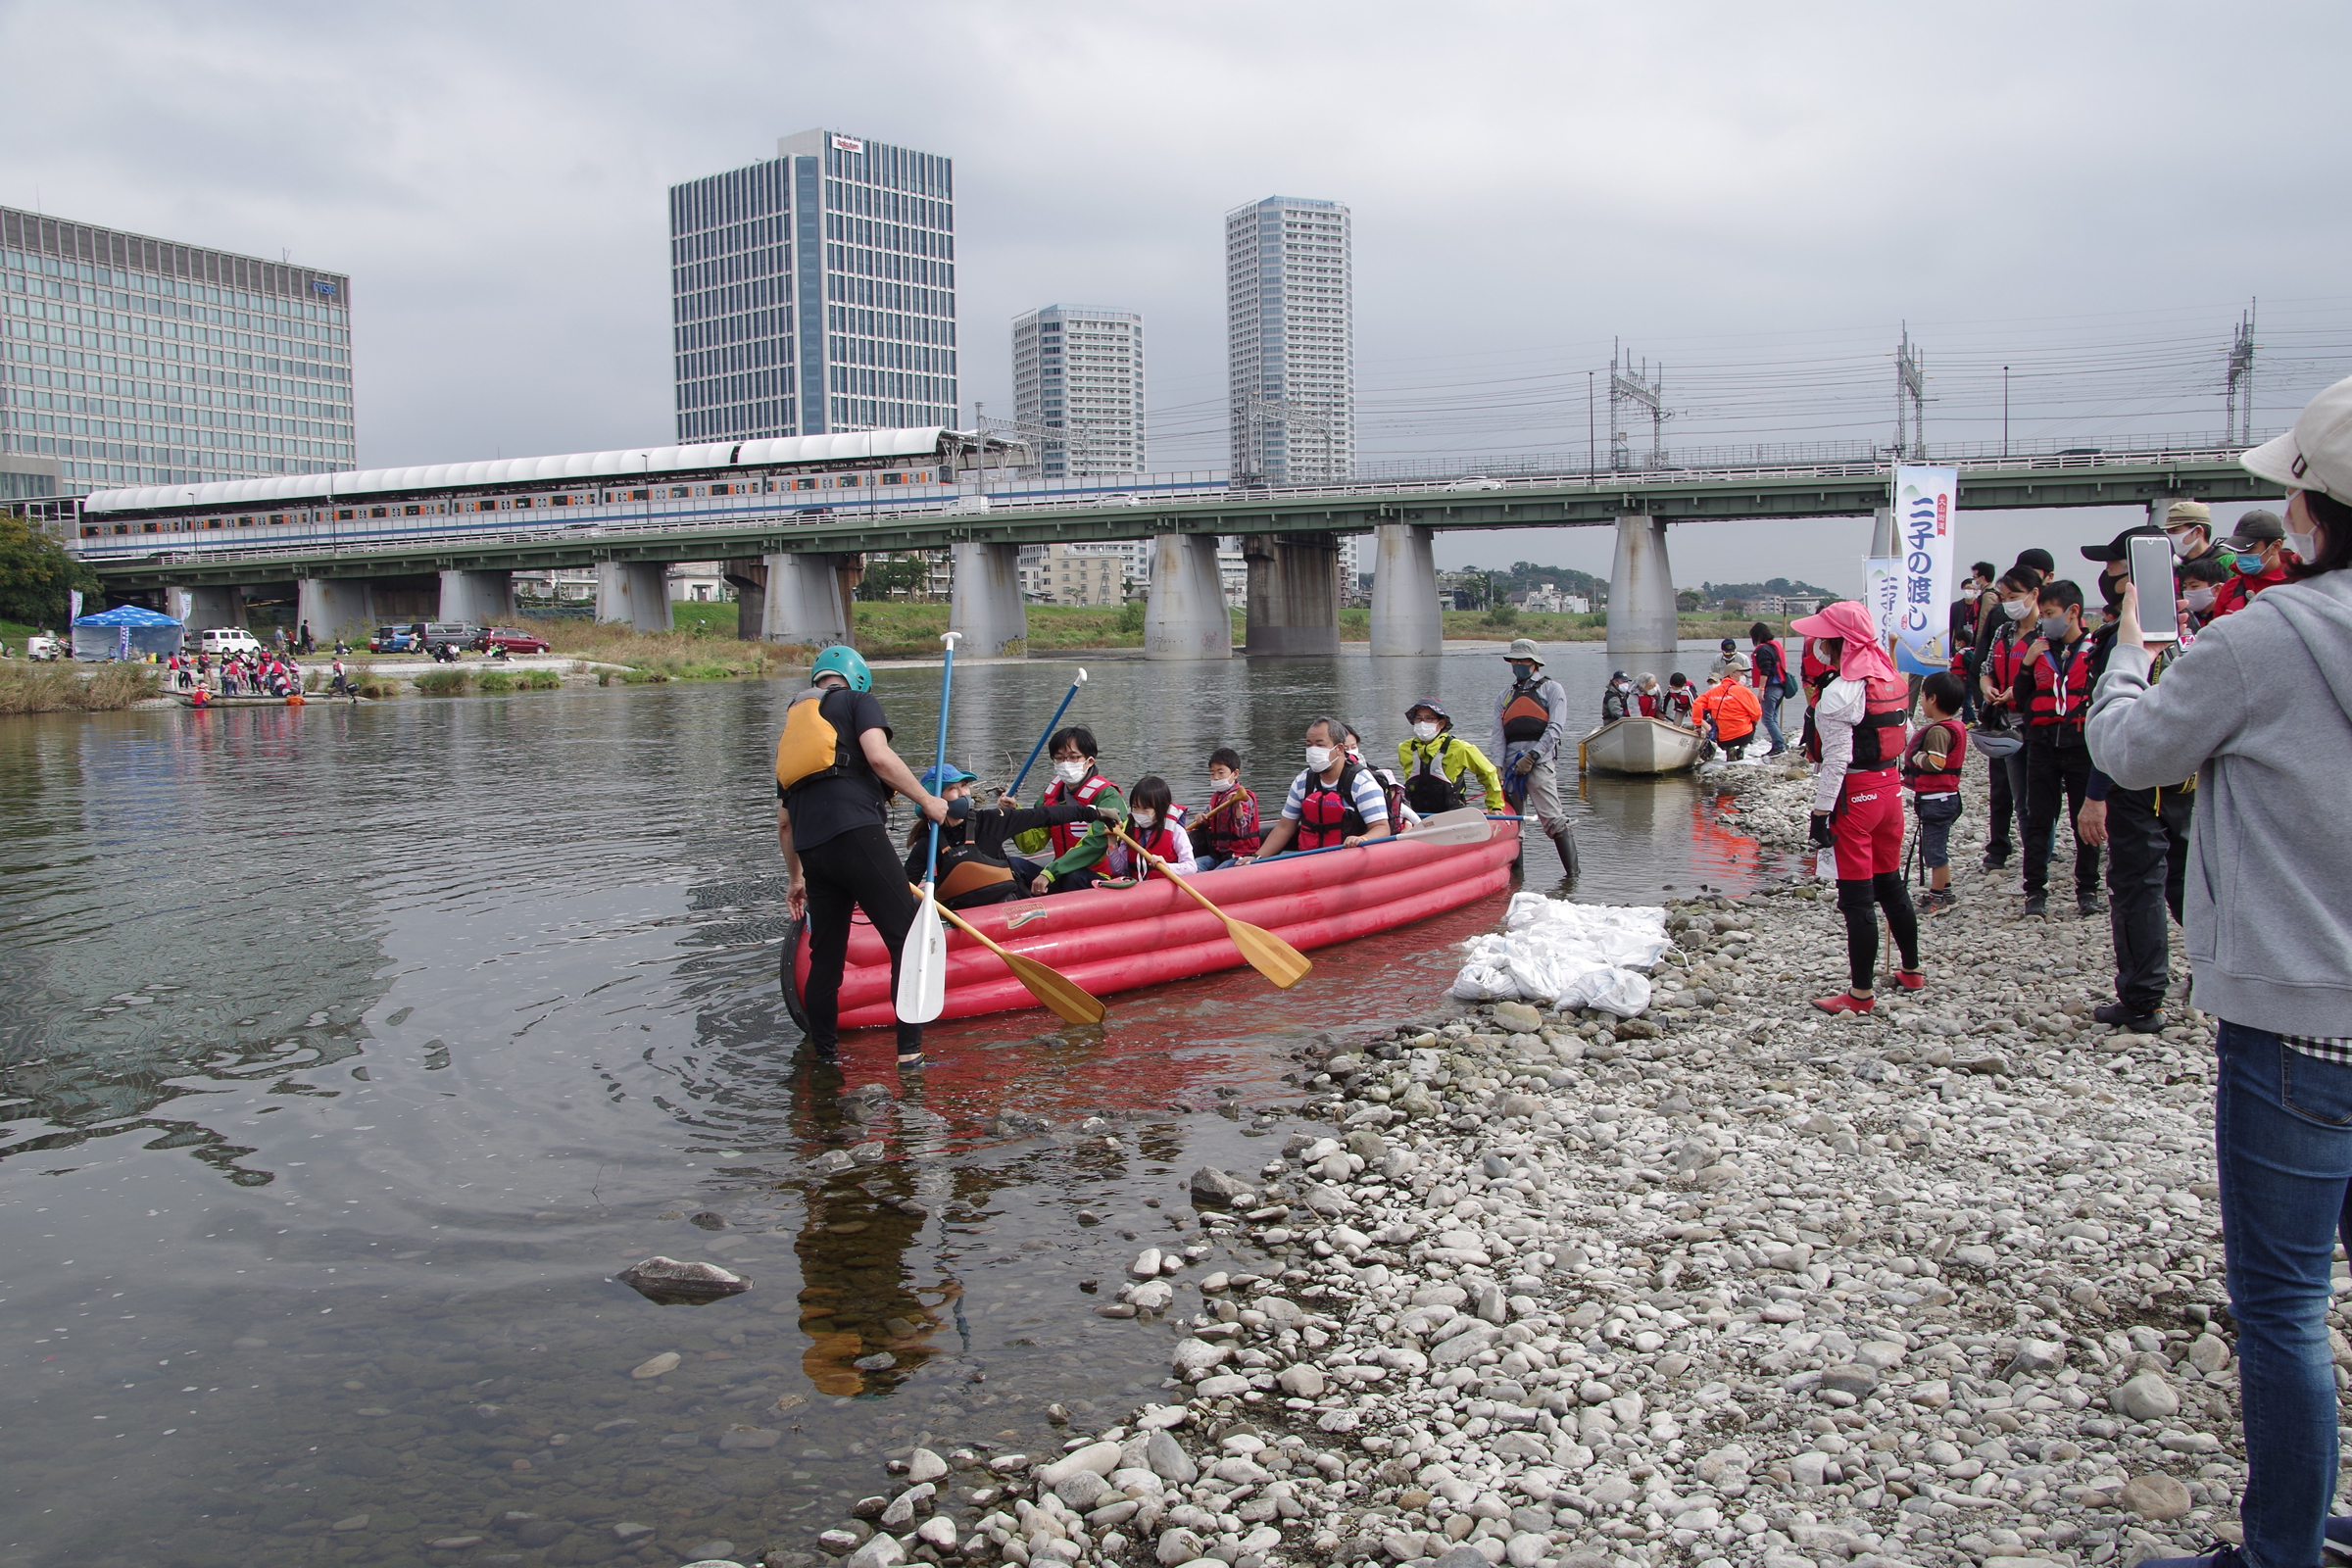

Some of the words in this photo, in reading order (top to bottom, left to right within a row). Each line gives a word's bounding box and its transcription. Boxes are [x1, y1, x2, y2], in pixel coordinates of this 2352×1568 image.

[313, 282, 336, 296] rise
[1937, 498, 1946, 530] 大山街道
[1907, 497, 1936, 632] 二子の渡し
[1851, 793, 1878, 803] oxbow
